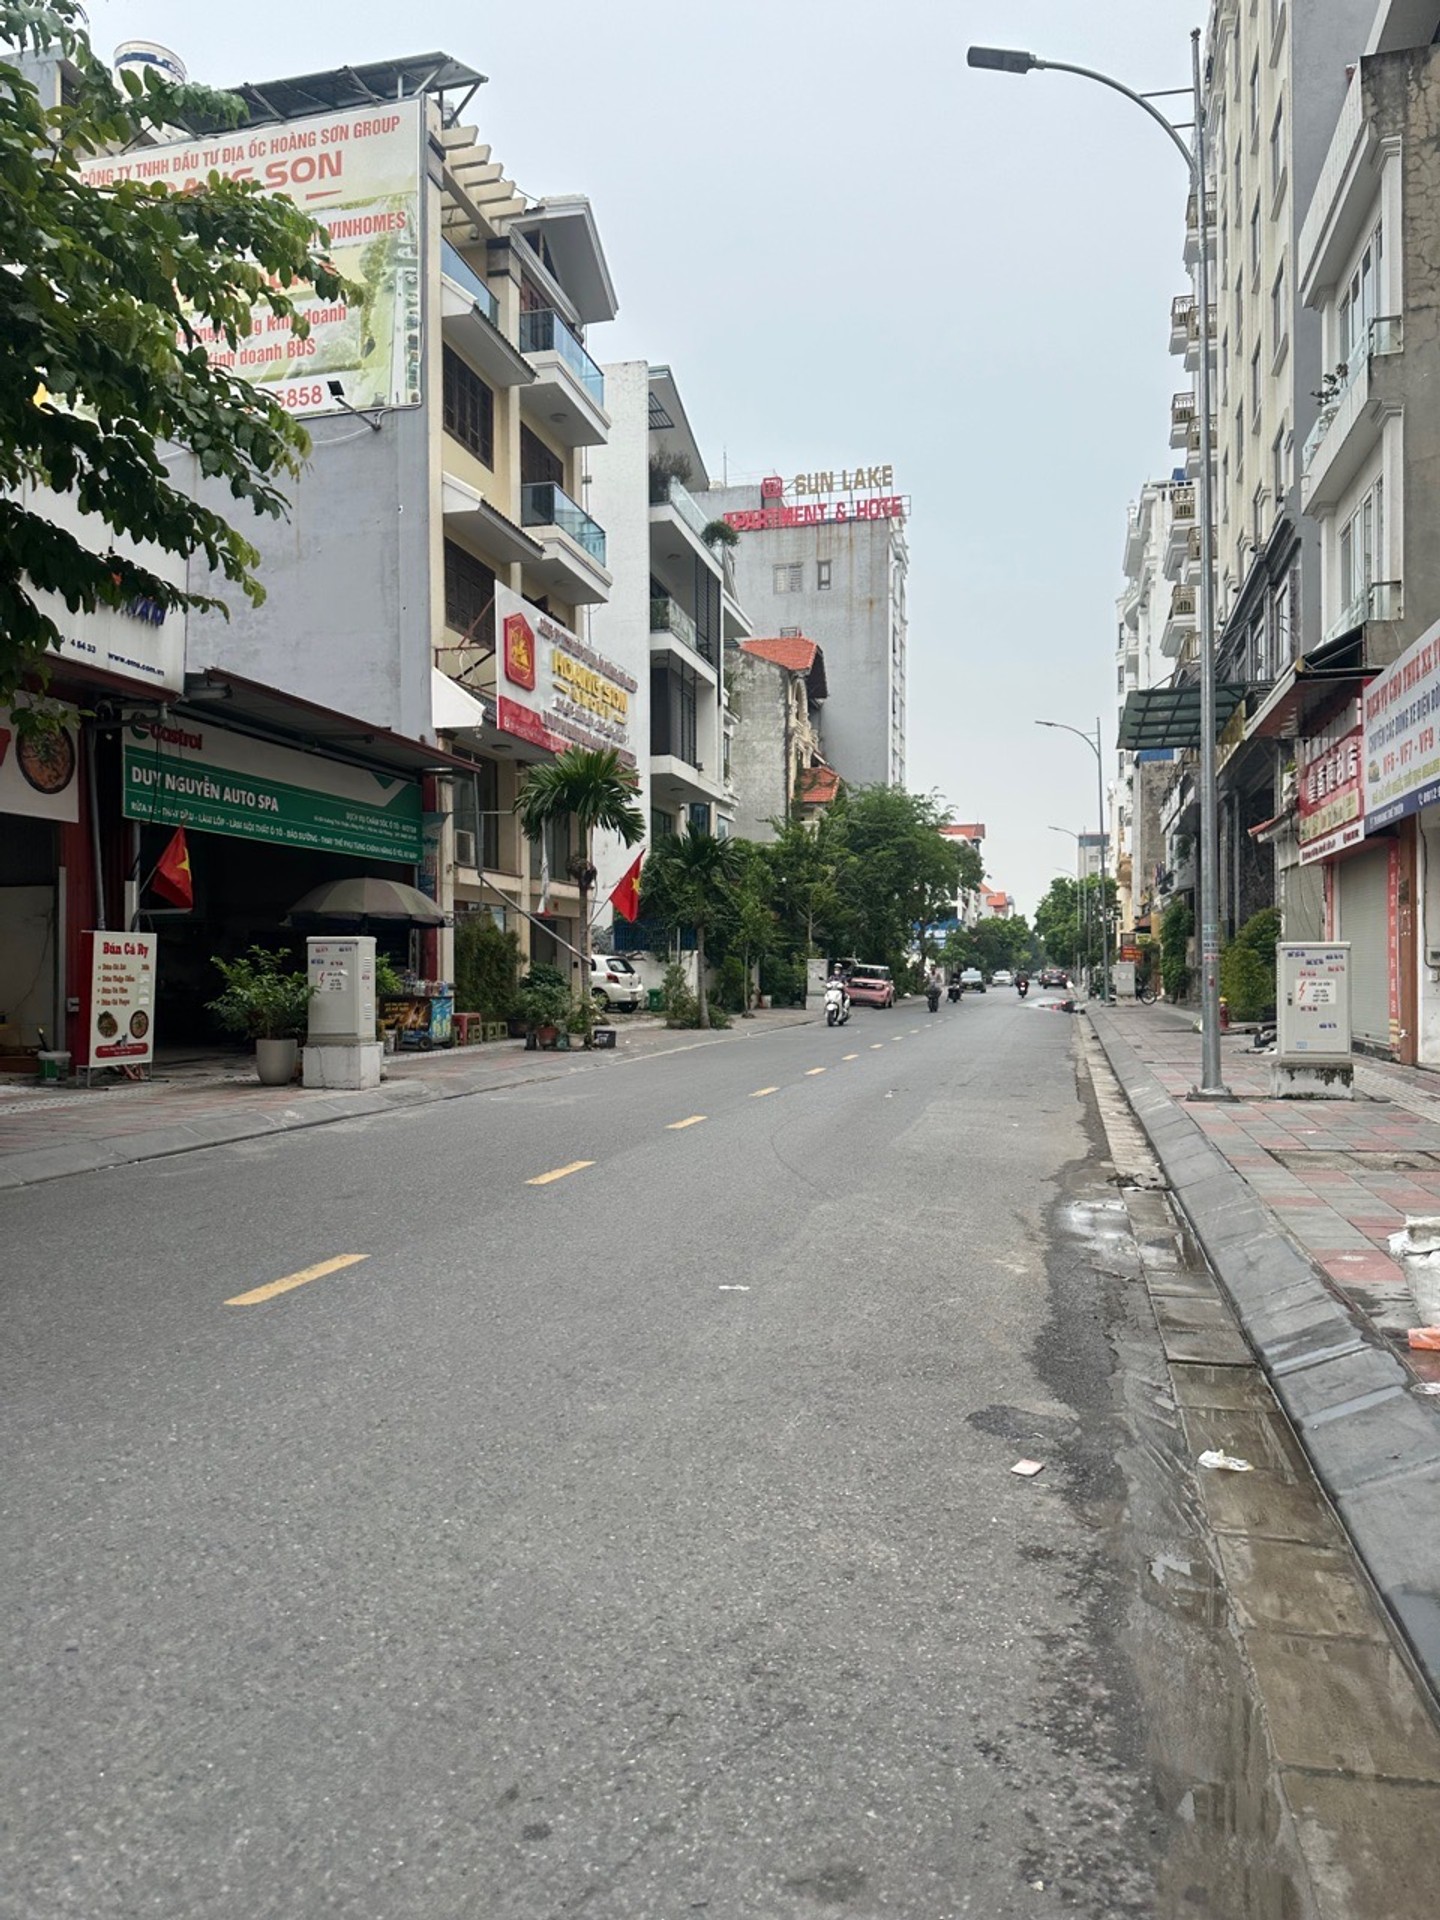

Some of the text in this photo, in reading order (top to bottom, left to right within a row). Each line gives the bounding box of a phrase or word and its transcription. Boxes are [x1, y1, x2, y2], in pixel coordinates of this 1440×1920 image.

[80, 115, 401, 185] CÔNG TY TNHH ĐẦU TƯ ĐỊA ỐC HOÀNG SƠN GROUP
[265, 150, 342, 189] SON
[327, 211, 406, 240] VINHOMES
[303, 304, 347, 326] doanh
[240, 343, 282, 365] doanh
[286, 338, 316, 359] BĐS
[794, 465, 893, 495] SUN LAKE
[835, 501, 847, 523] &
[1400, 739, 1413, 766] VF7
[1419, 727, 1434, 754] VF9
[132, 766, 279, 812] DUY NGUYỄN AUTO SPA
